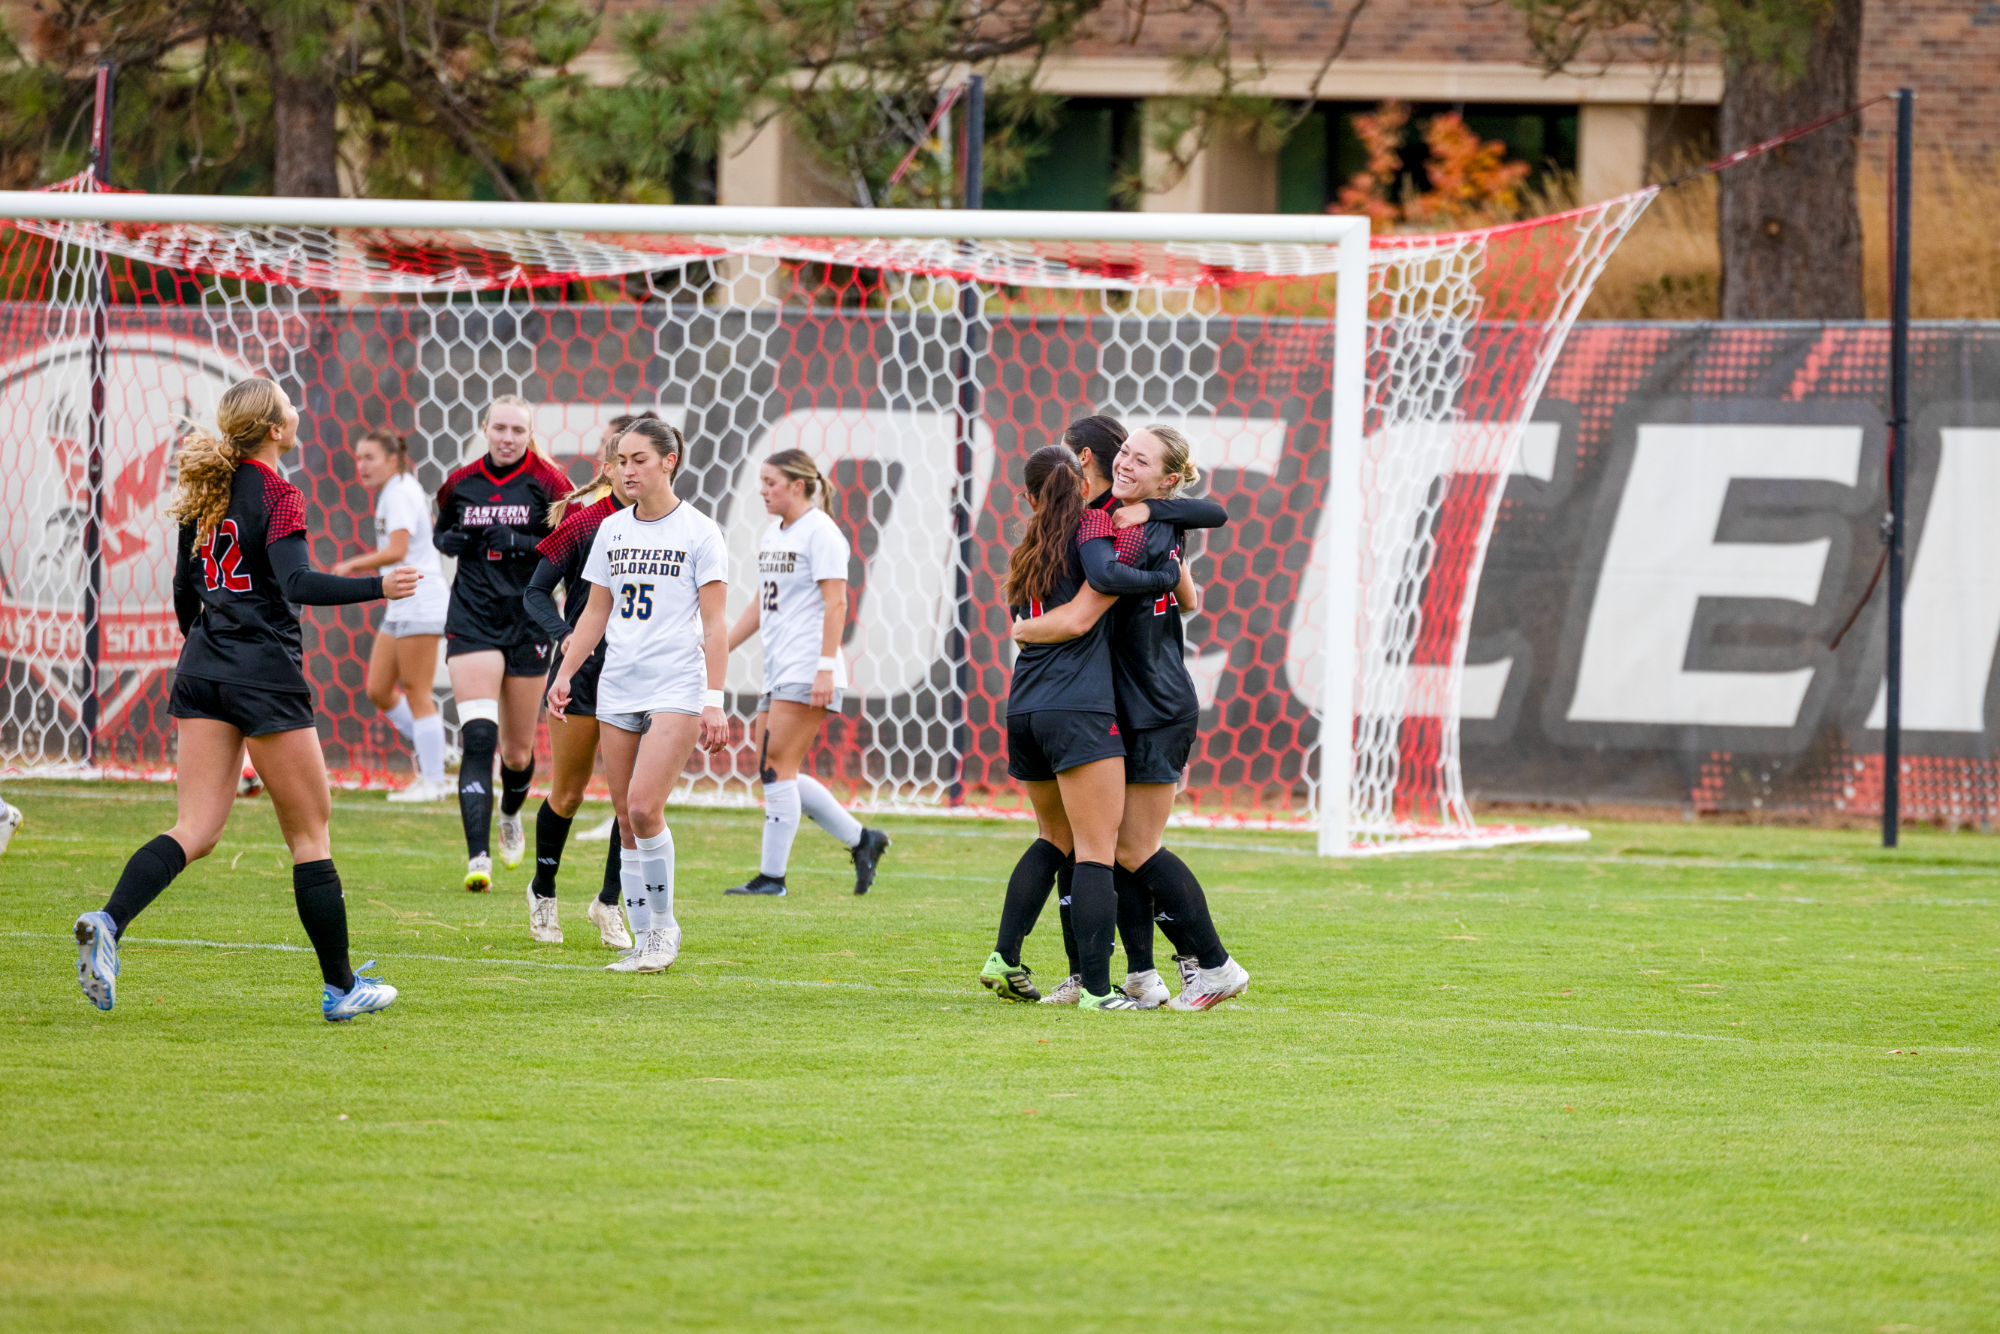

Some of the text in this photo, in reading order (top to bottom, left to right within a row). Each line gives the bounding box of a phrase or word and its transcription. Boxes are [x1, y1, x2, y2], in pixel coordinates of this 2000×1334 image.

[464, 504, 531, 518] EASTERN
[463, 516, 530, 526] WASHIGTON
[606, 547, 687, 564] NORTHERN
[610, 561, 681, 578] COLORADO
[620, 582, 655, 621] 35
[763, 580, 779, 612] 22
